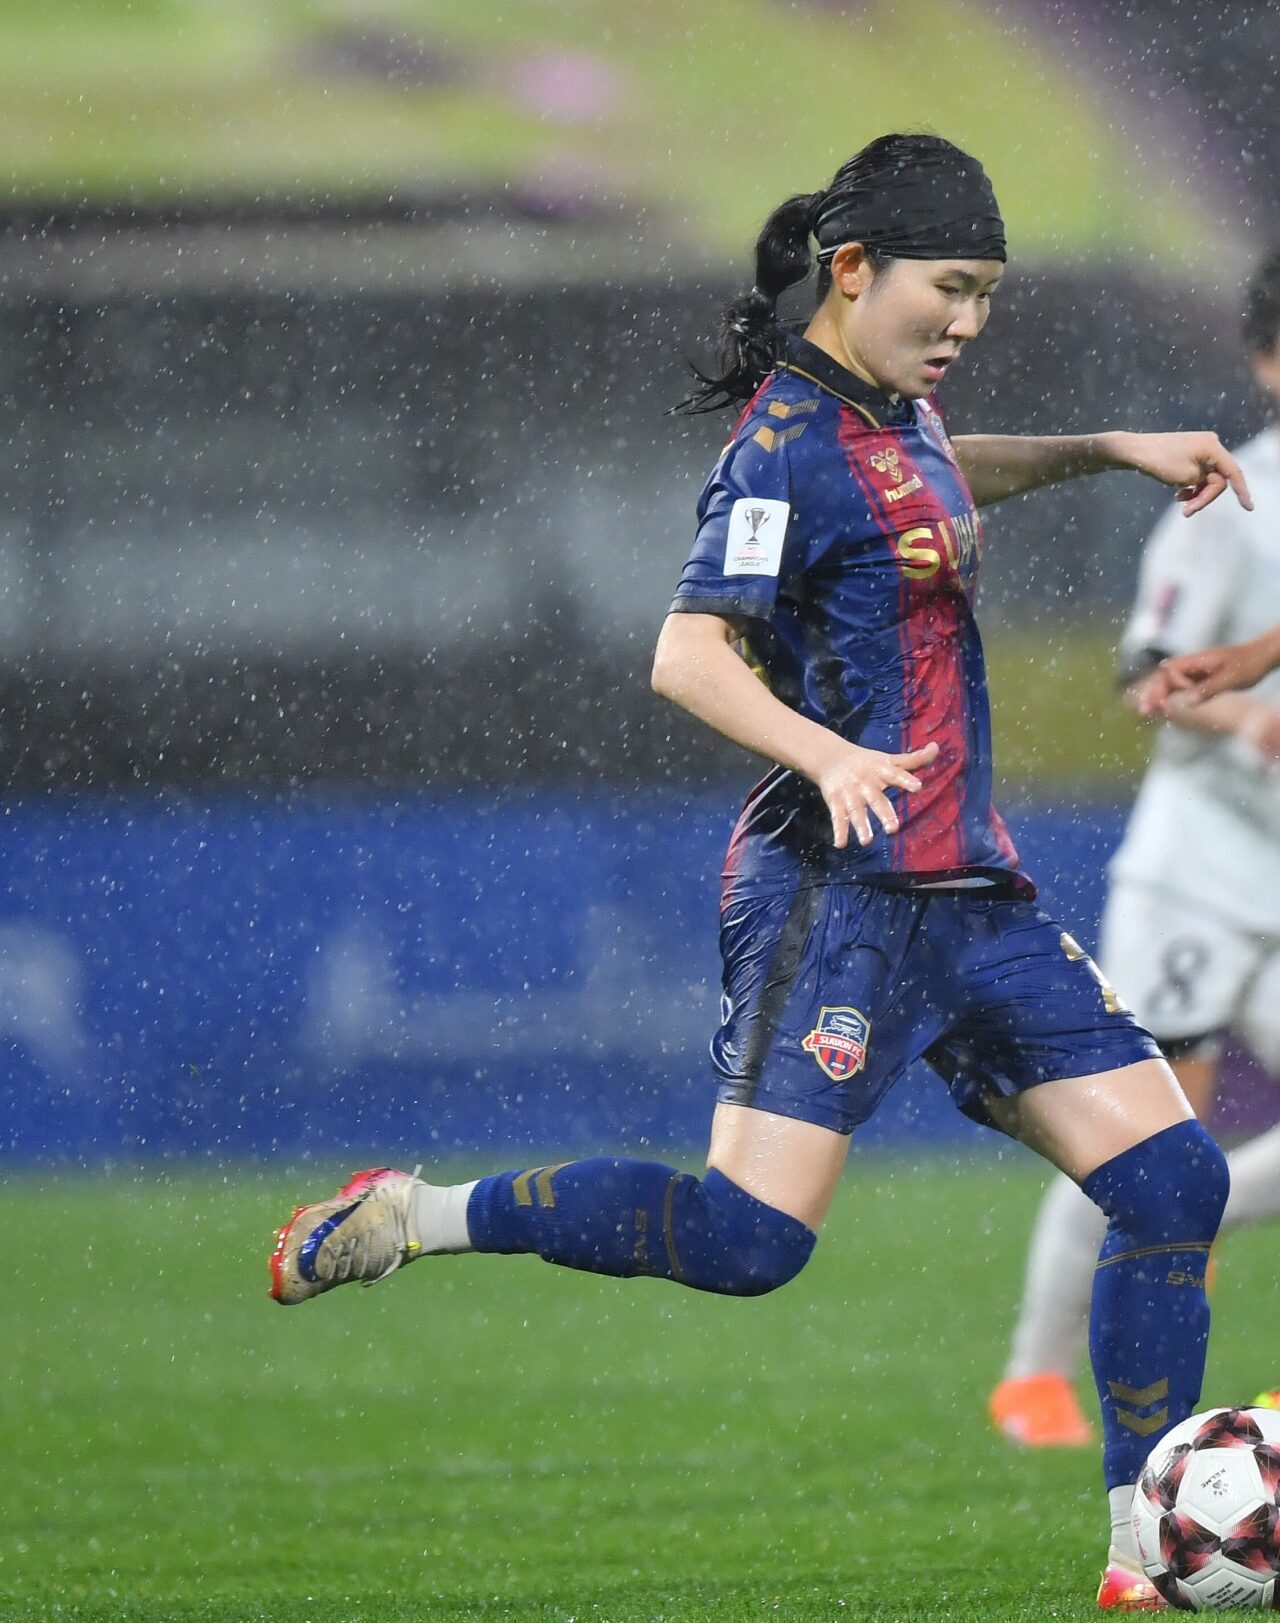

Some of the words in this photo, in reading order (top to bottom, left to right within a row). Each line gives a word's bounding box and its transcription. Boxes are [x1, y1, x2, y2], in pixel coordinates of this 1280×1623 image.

[1146, 936, 1210, 1020] 8
[819, 1036, 852, 1050] SUWON
[851, 1045, 863, 1056] FC
